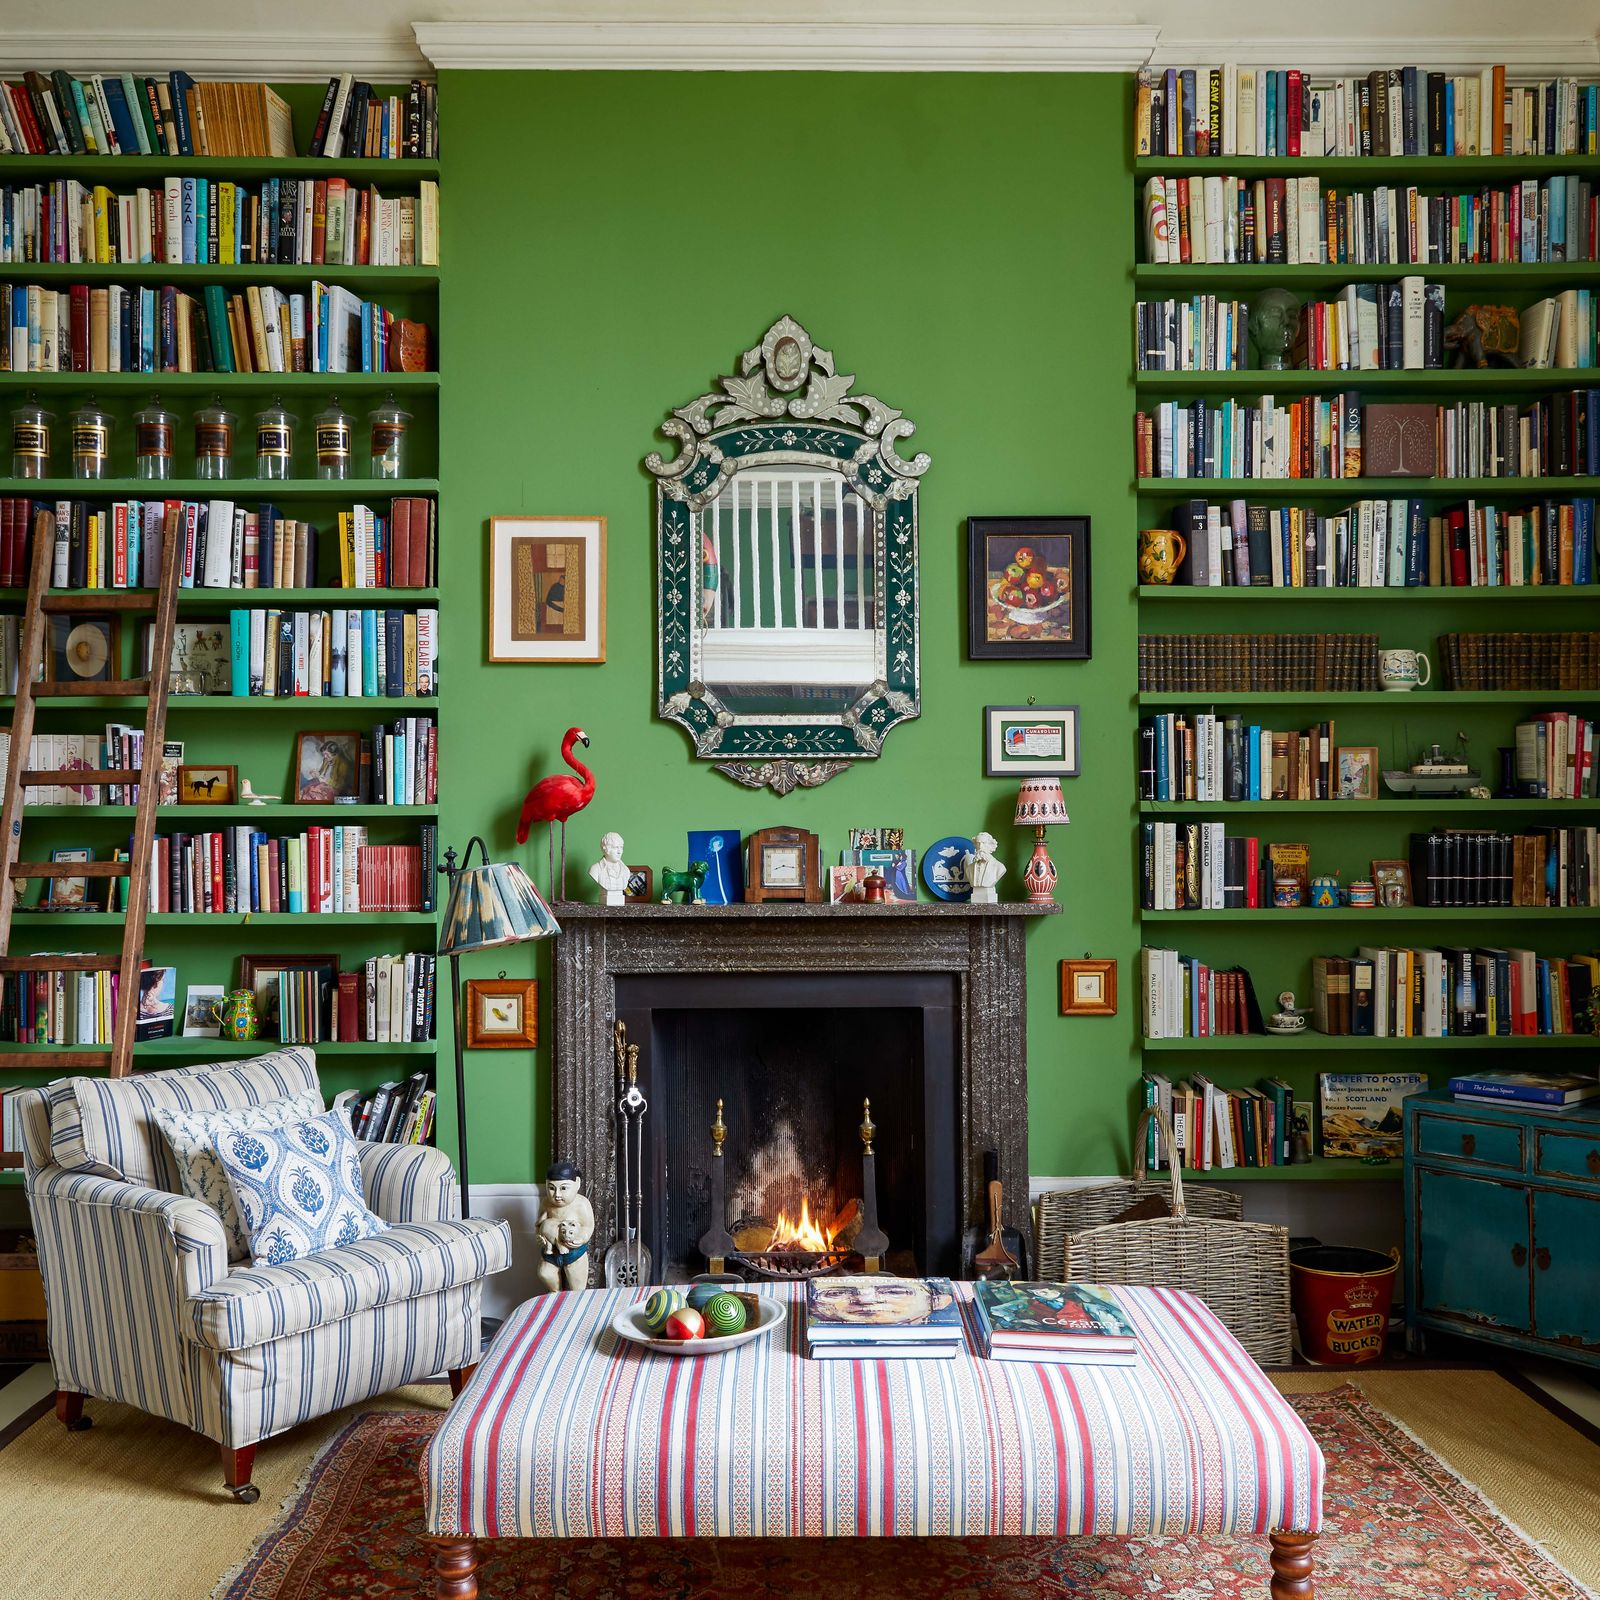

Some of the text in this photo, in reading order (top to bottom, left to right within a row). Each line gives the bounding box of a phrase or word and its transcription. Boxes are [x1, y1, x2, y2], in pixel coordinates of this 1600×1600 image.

[1210, 80, 1219, 102] SAW
[1377, 74, 1385, 113] MAILER
[166, 189, 180, 222] Oprah
[184, 181, 192, 224] GAZA
[1349, 408, 1357, 432] SON
[419, 614, 429, 667] TONY BLAIR
[1463, 953, 1472, 1006] DEAD MEN RISEN
[416, 988, 424, 1026] PROFILES
[1042, 1317, 1125, 1328] Cézanne
[1333, 1315, 1380, 1332] WATER
[1332, 1336, 1381, 1352] BUCKET
